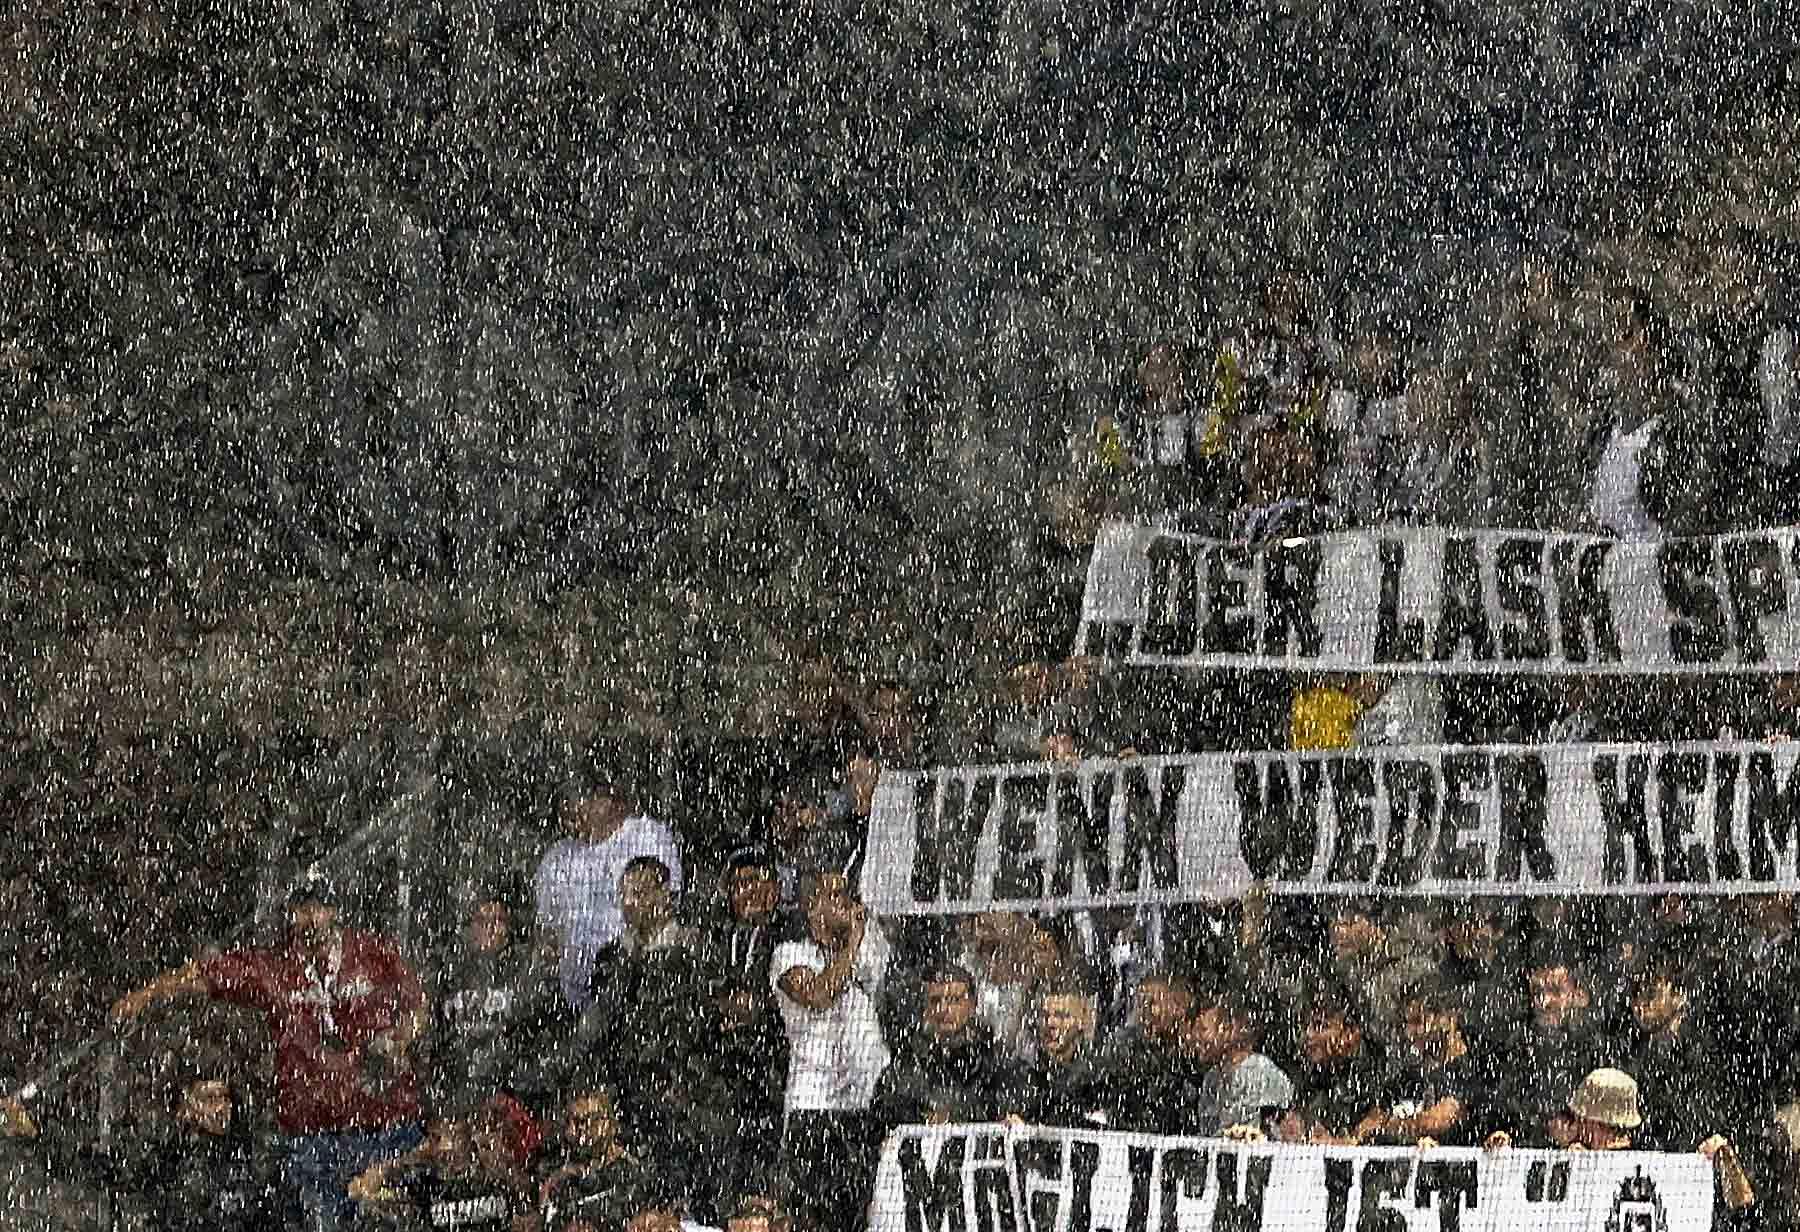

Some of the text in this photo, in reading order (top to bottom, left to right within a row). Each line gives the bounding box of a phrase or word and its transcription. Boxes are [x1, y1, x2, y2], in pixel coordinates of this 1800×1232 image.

[1373, 538, 1621, 663] LASK
[912, 756, 1190, 902] WENN
[1234, 750, 1554, 886] WEDER
